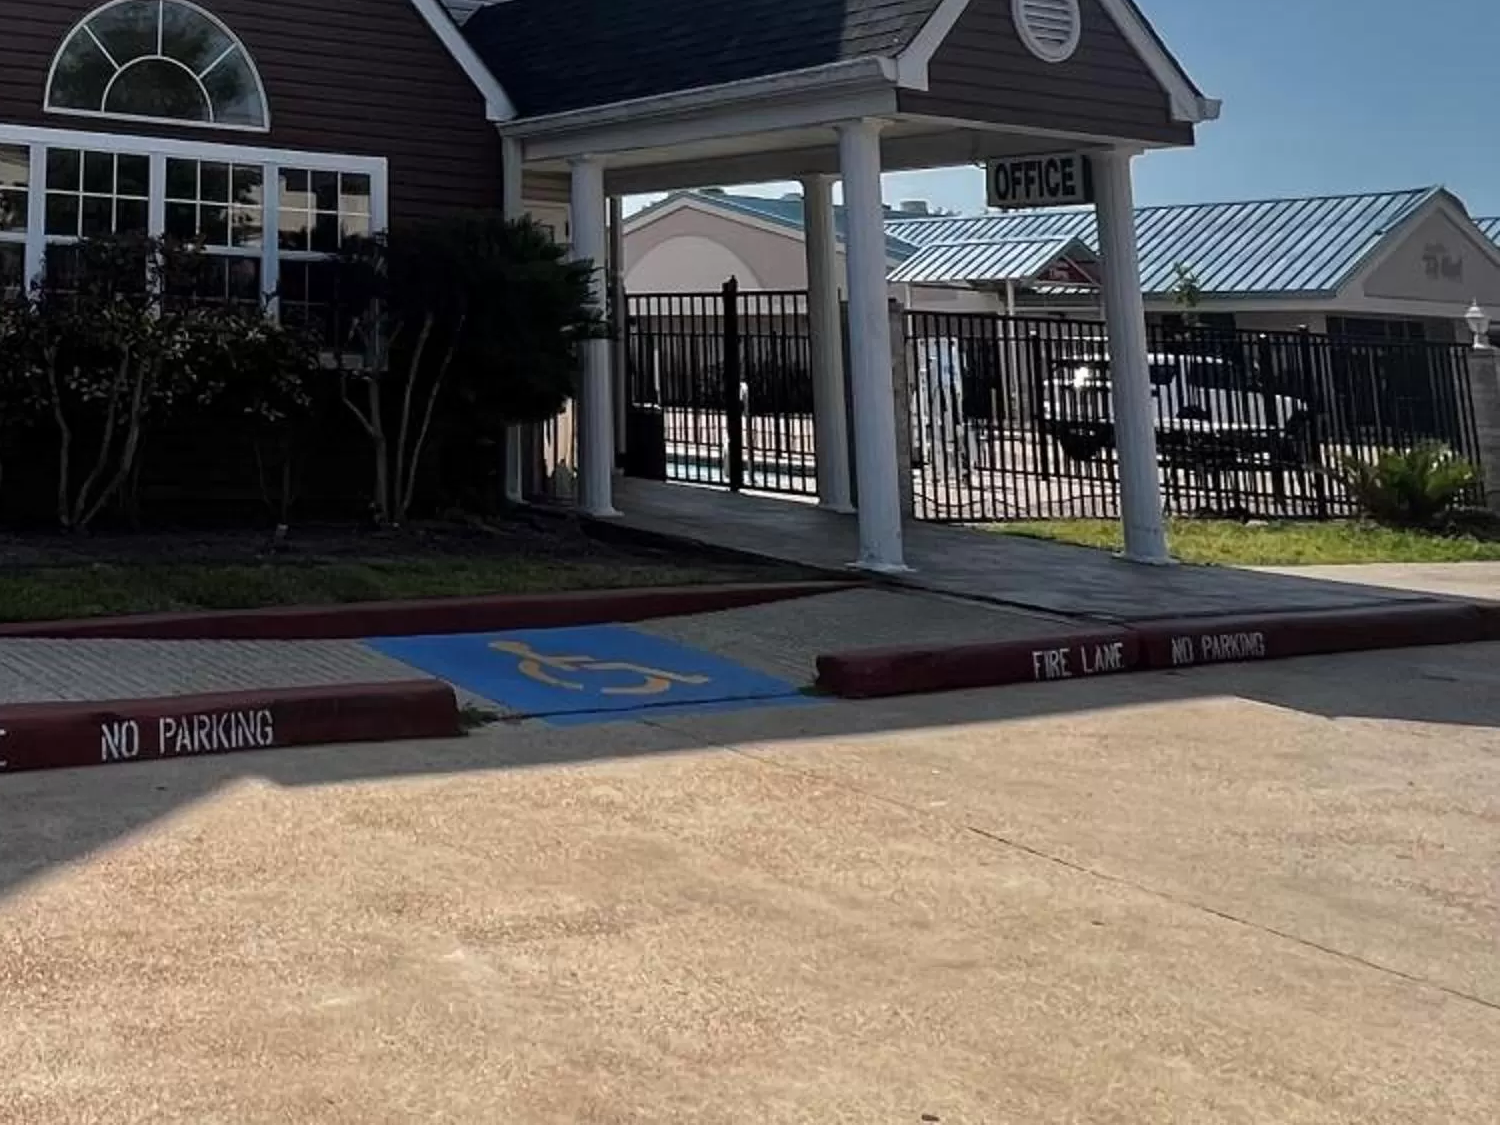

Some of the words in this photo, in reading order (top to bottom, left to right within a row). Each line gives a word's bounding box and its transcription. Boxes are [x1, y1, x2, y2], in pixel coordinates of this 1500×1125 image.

[995, 157, 1076, 200] OFFICE
[1032, 648, 1072, 679] FIRE
[1080, 642, 1124, 673] LANE
[1171, 635, 1194, 665] NO
[1201, 632, 1265, 659] PARKING
[101, 719, 139, 762] NO
[158, 710, 274, 754] PARKING
